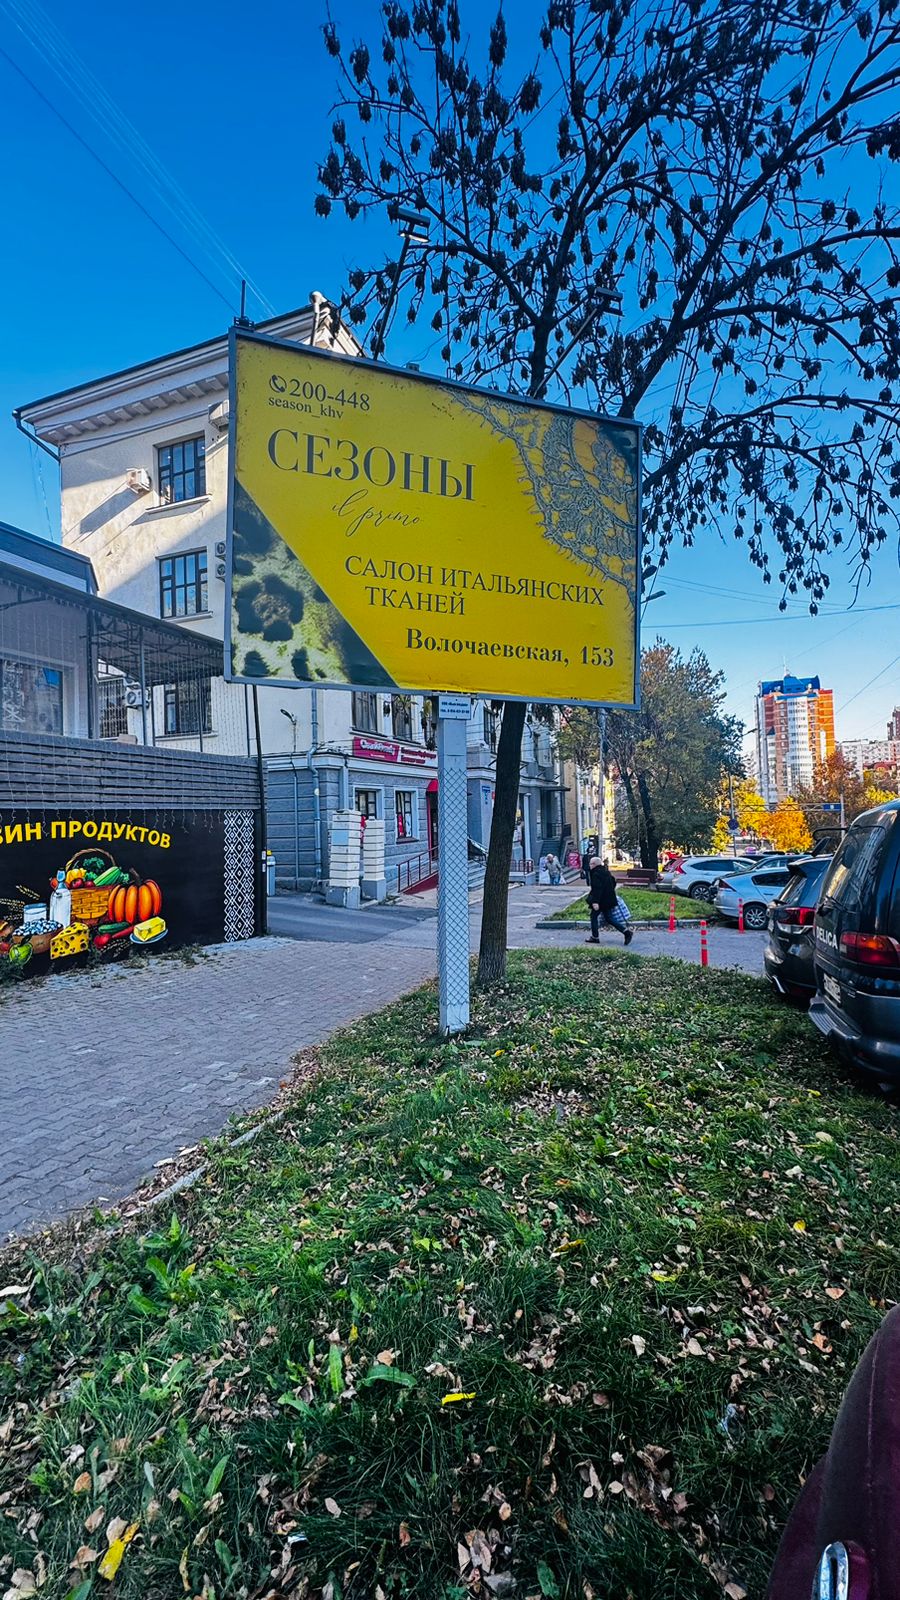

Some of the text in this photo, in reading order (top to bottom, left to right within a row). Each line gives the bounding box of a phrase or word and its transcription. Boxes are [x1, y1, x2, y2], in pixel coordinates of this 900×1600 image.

[268, 396, 344, 420] season_khv
[289, 378, 371, 412] 200-448
[267, 428, 476, 501] СЕЗОНЫ
[347, 506, 421, 537] primo
[345, 555, 604, 606] САЛОН ИТАЛЬЯНСКИХ
[365, 586, 466, 616] ТКАНЕЙ
[406, 628, 615, 668] Волочаевская, 153
[0, 820, 171, 849] ИН ПРОДУКТОВ
[816, 926, 838, 950] DELICA
